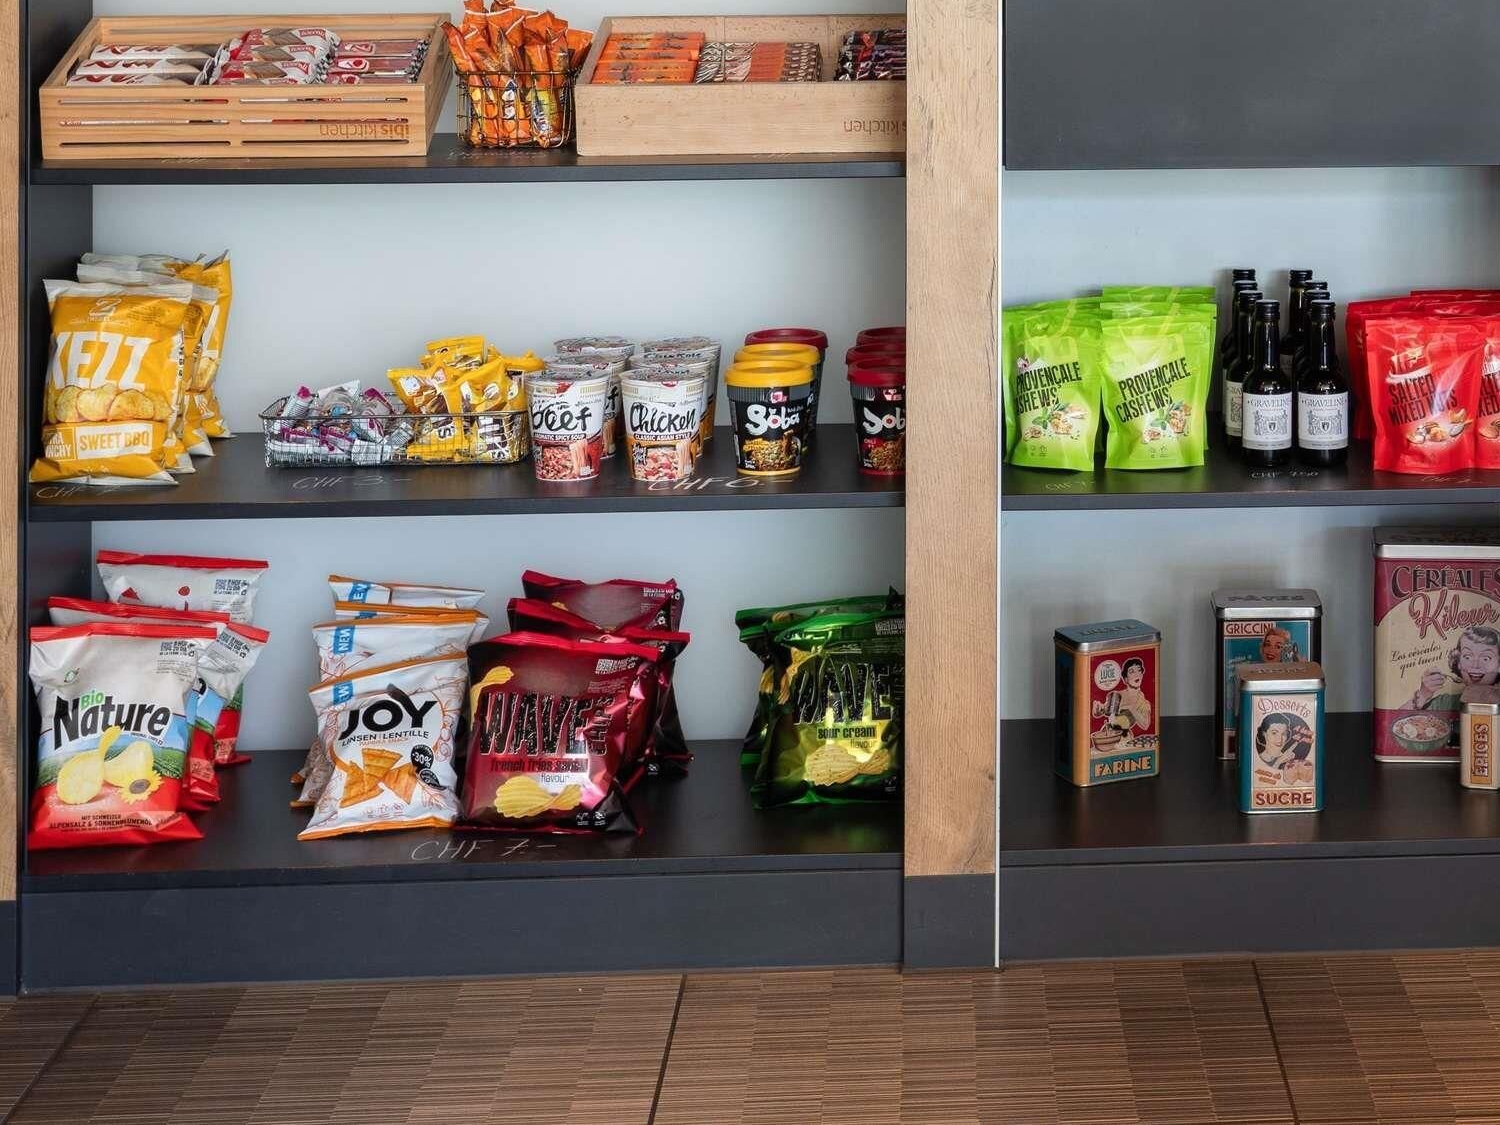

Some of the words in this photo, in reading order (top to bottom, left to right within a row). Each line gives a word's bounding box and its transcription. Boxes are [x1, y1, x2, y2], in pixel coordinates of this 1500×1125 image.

[319, 122, 377, 139] kitchen
[381, 123, 410, 138] ibis
[843, 120, 898, 136] kitchen
[1118, 357, 1191, 401] PROVENÇALE
[1389, 374, 1437, 406] SALTED
[1115, 388, 1173, 424] CASHEWS
[1388, 400, 1427, 425] MIXED
[630, 402, 697, 434] Chicken
[745, 404, 801, 437] Soba
[79, 432, 121, 451] SWEET
[124, 429, 150, 448] BBQ
[337, 628, 351, 653] NEW
[1391, 649, 1406, 663] Les
[1407, 642, 1442, 659] céréales
[80, 689, 105, 710] Bio
[1257, 696, 1312, 719] Desserts
[54, 695, 171, 751] Nature
[338, 683, 438, 741] JOY
[342, 734, 377, 747] LINSEN
[382, 730, 430, 740] LENTILLE
[818, 727, 841, 739] sour
[843, 726, 876, 738] cream
[1094, 756, 1153, 778] FARINE
[1256, 792, 1313, 806] SUCRE
[412, 839, 490, 860] CHF
